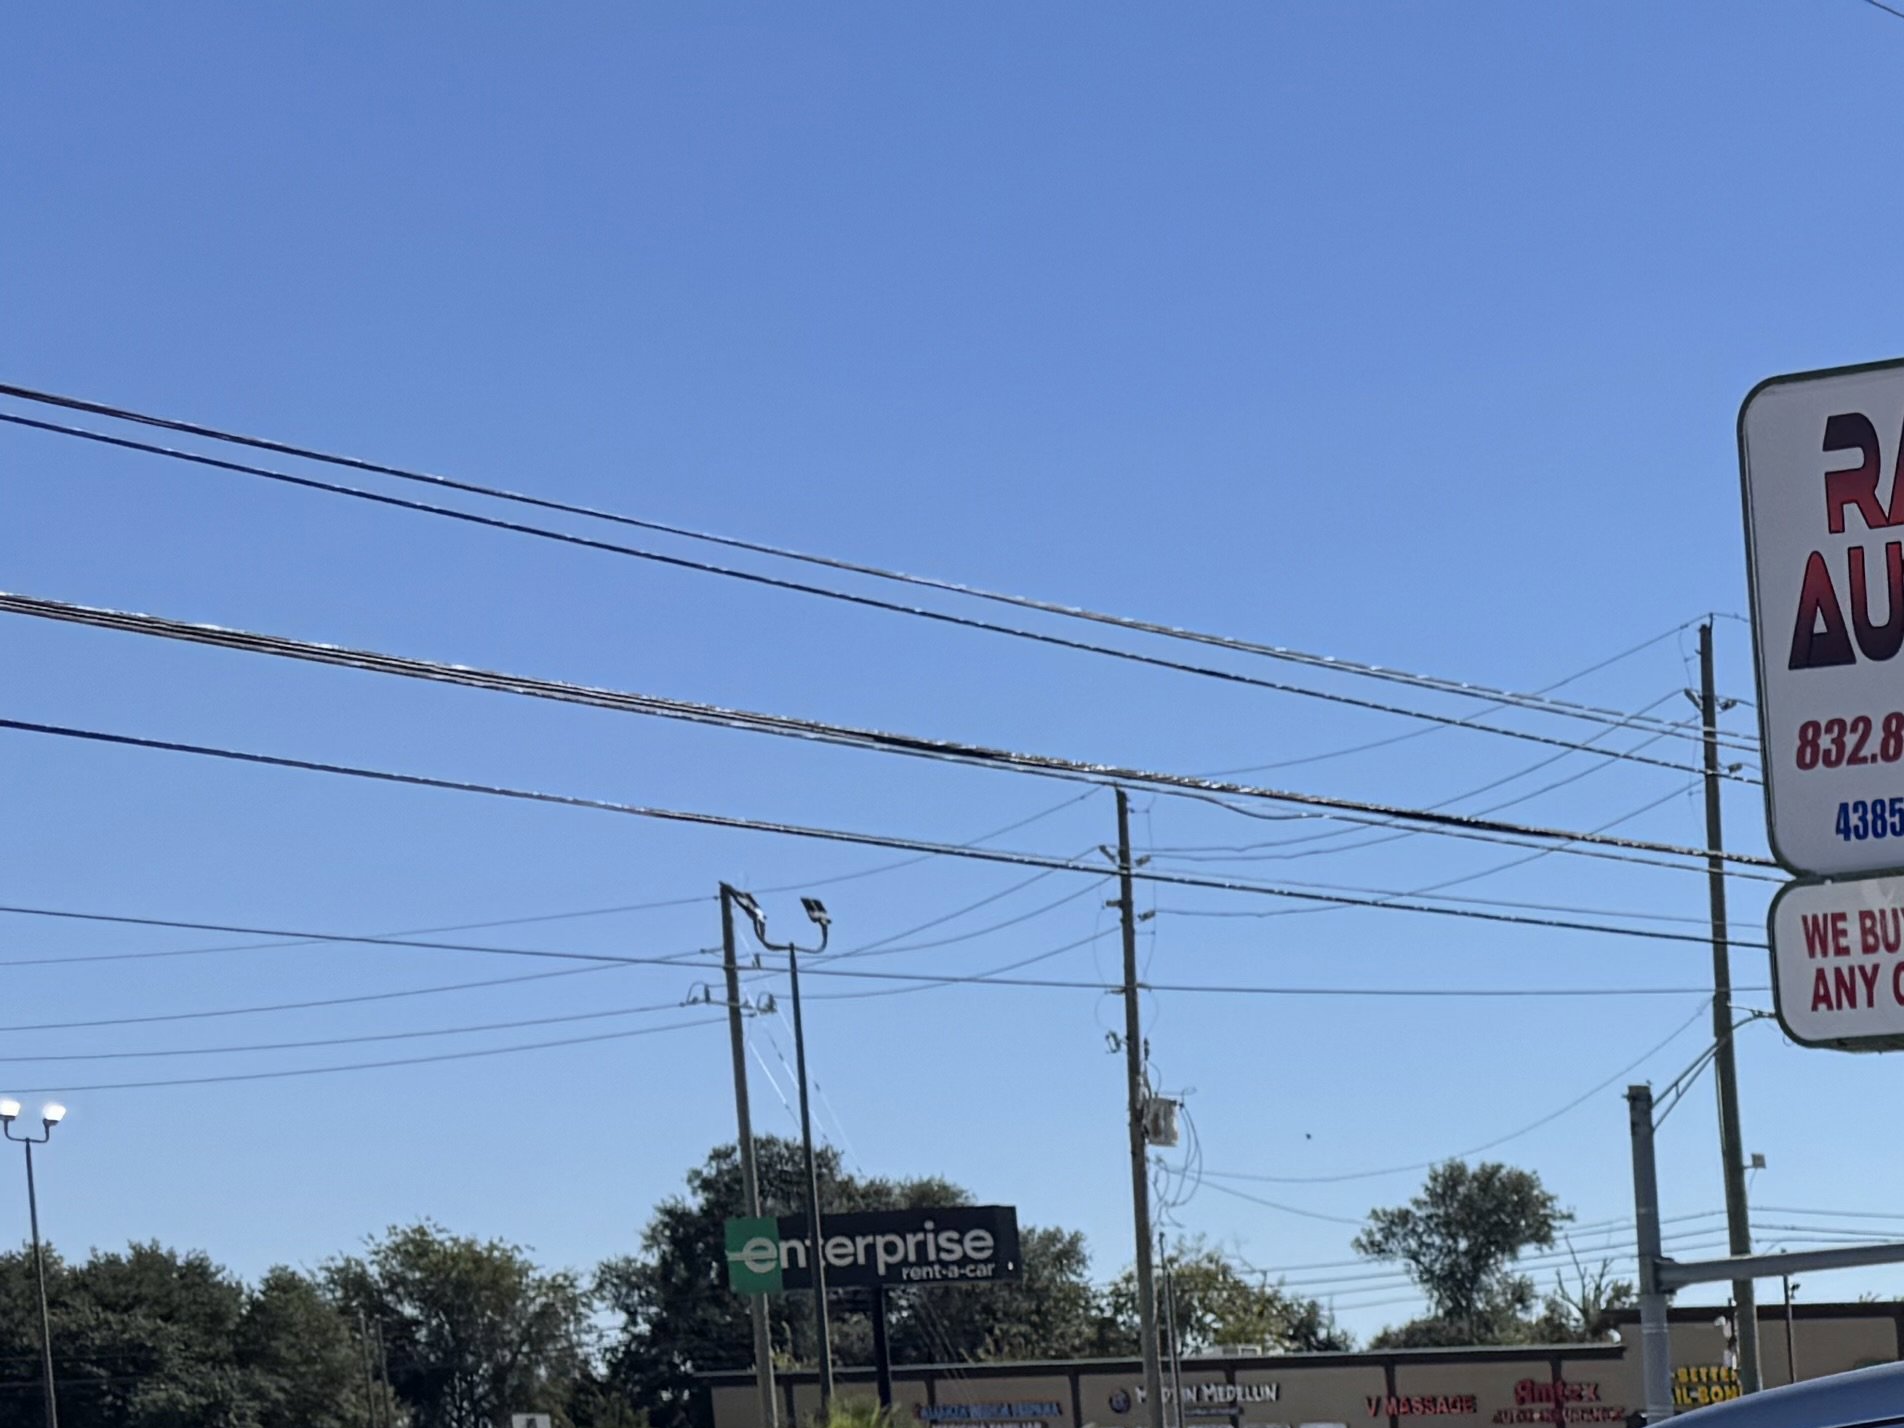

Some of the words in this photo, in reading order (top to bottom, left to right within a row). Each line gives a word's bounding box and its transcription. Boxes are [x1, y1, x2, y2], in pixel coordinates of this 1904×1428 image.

[1802, 911, 1849, 959] WE
[1810, 962, 1881, 1013] ANY
[740, 1220, 995, 1276] enerprise
[1365, 1396, 1377, 1418] V
[1385, 1394, 1476, 1417] MASSAGE
